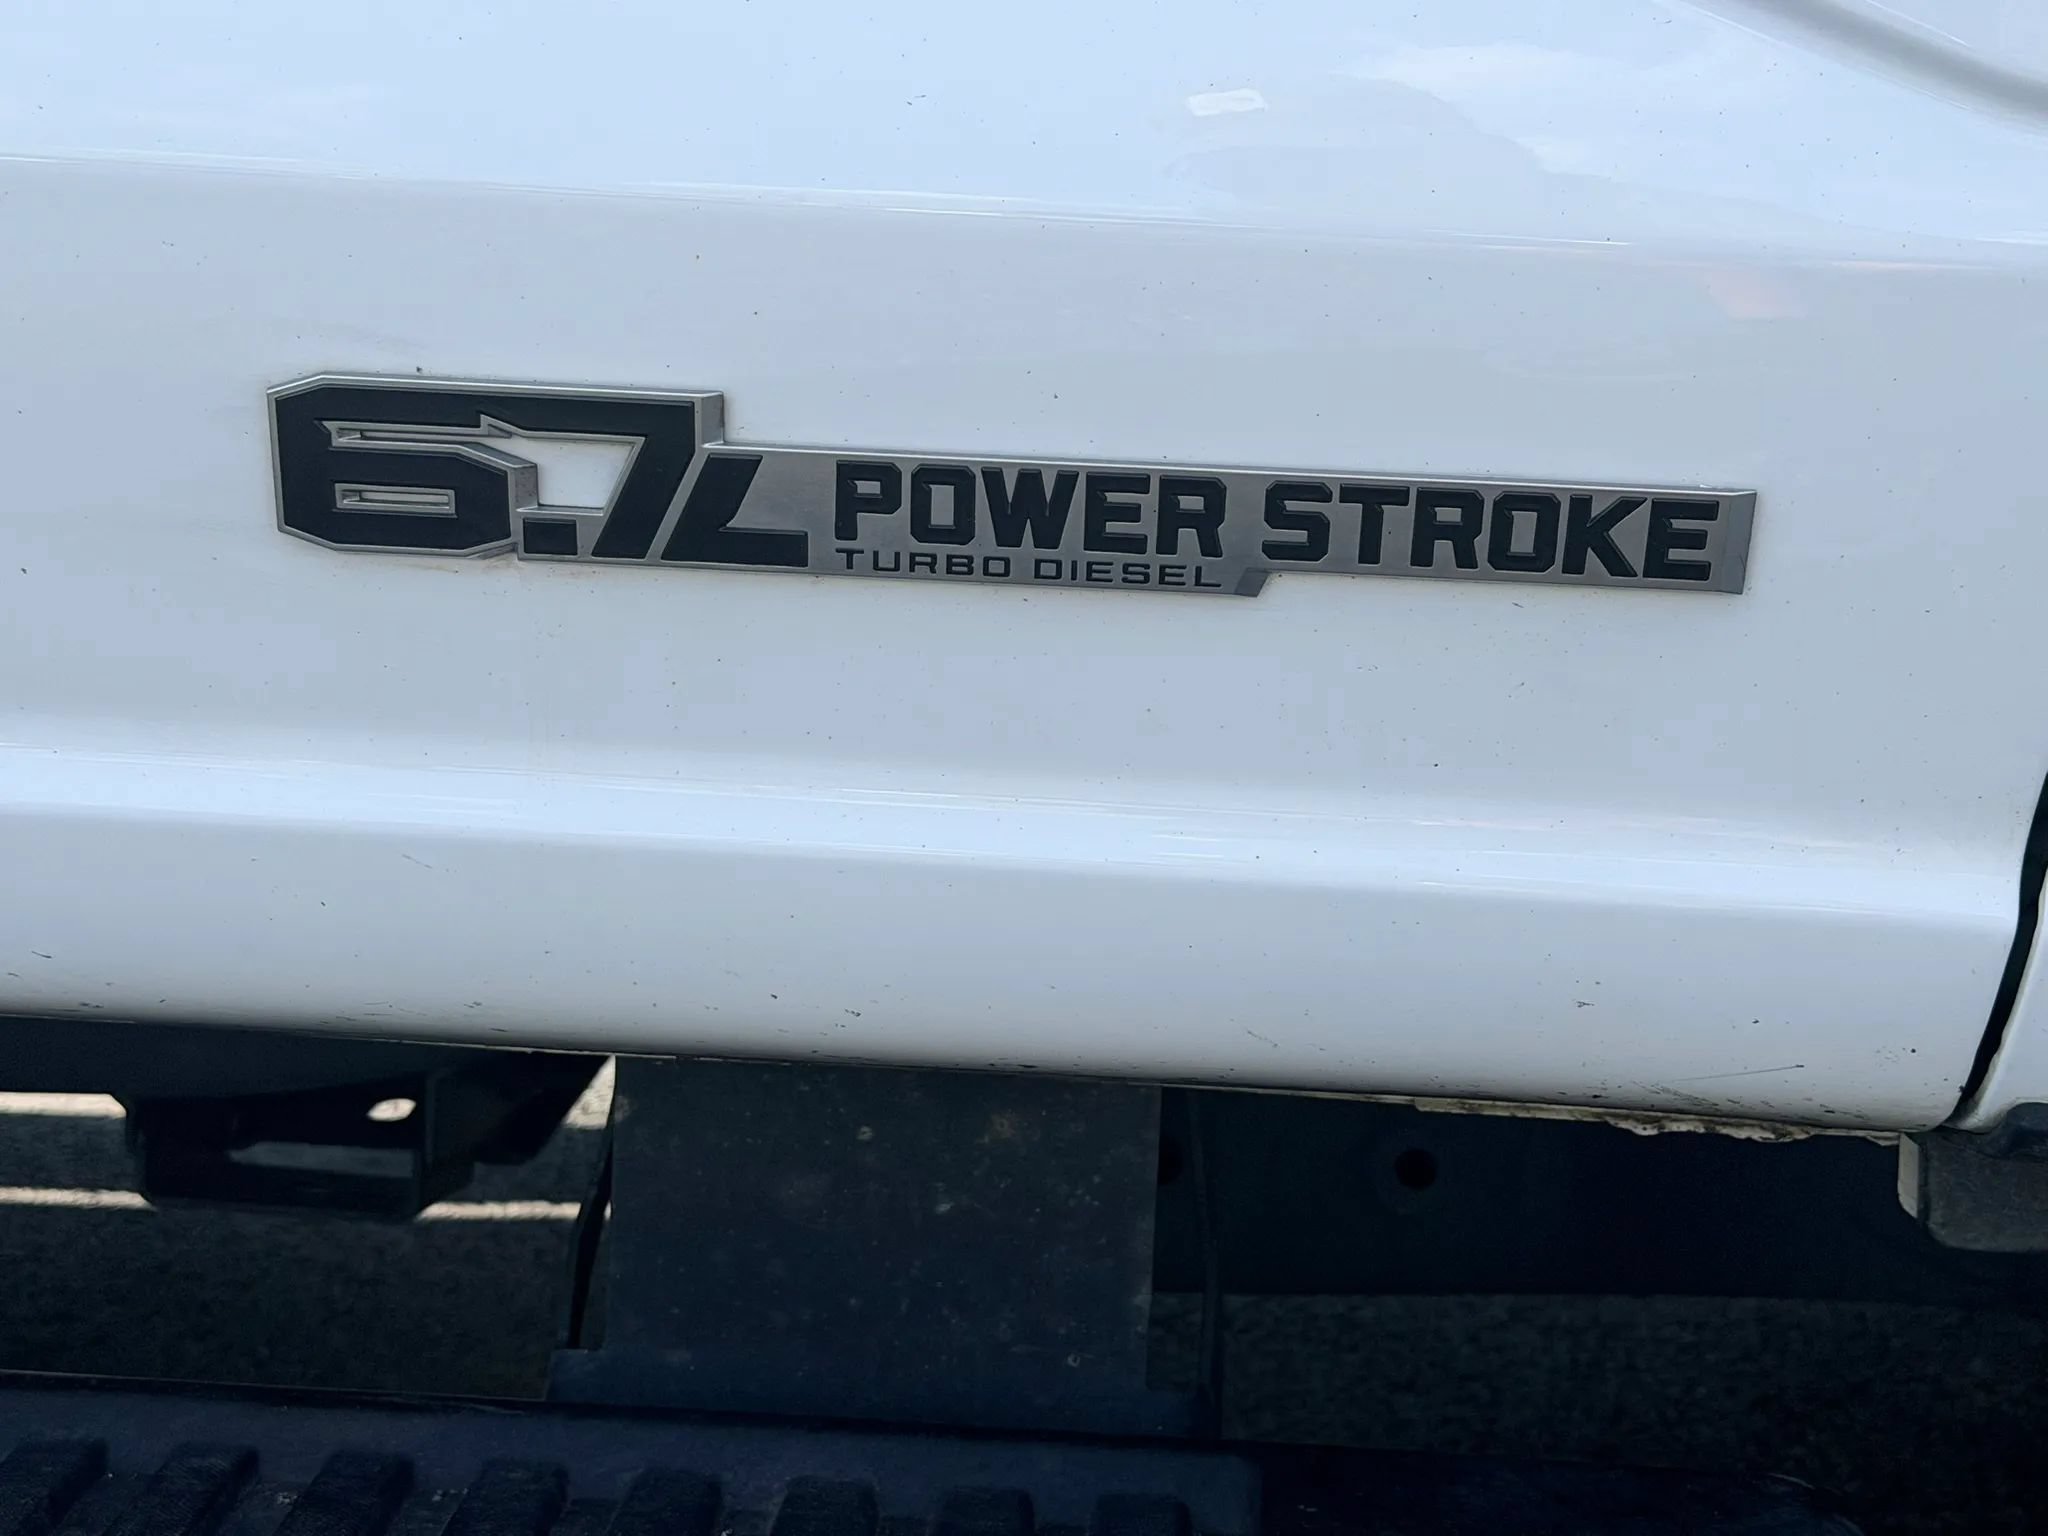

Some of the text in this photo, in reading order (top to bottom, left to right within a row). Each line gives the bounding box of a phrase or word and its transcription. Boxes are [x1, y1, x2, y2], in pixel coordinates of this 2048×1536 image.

[275, 386, 1720, 581] 6.7L POWER STROKE
[835, 548, 1222, 588] TURBO DIESEL
